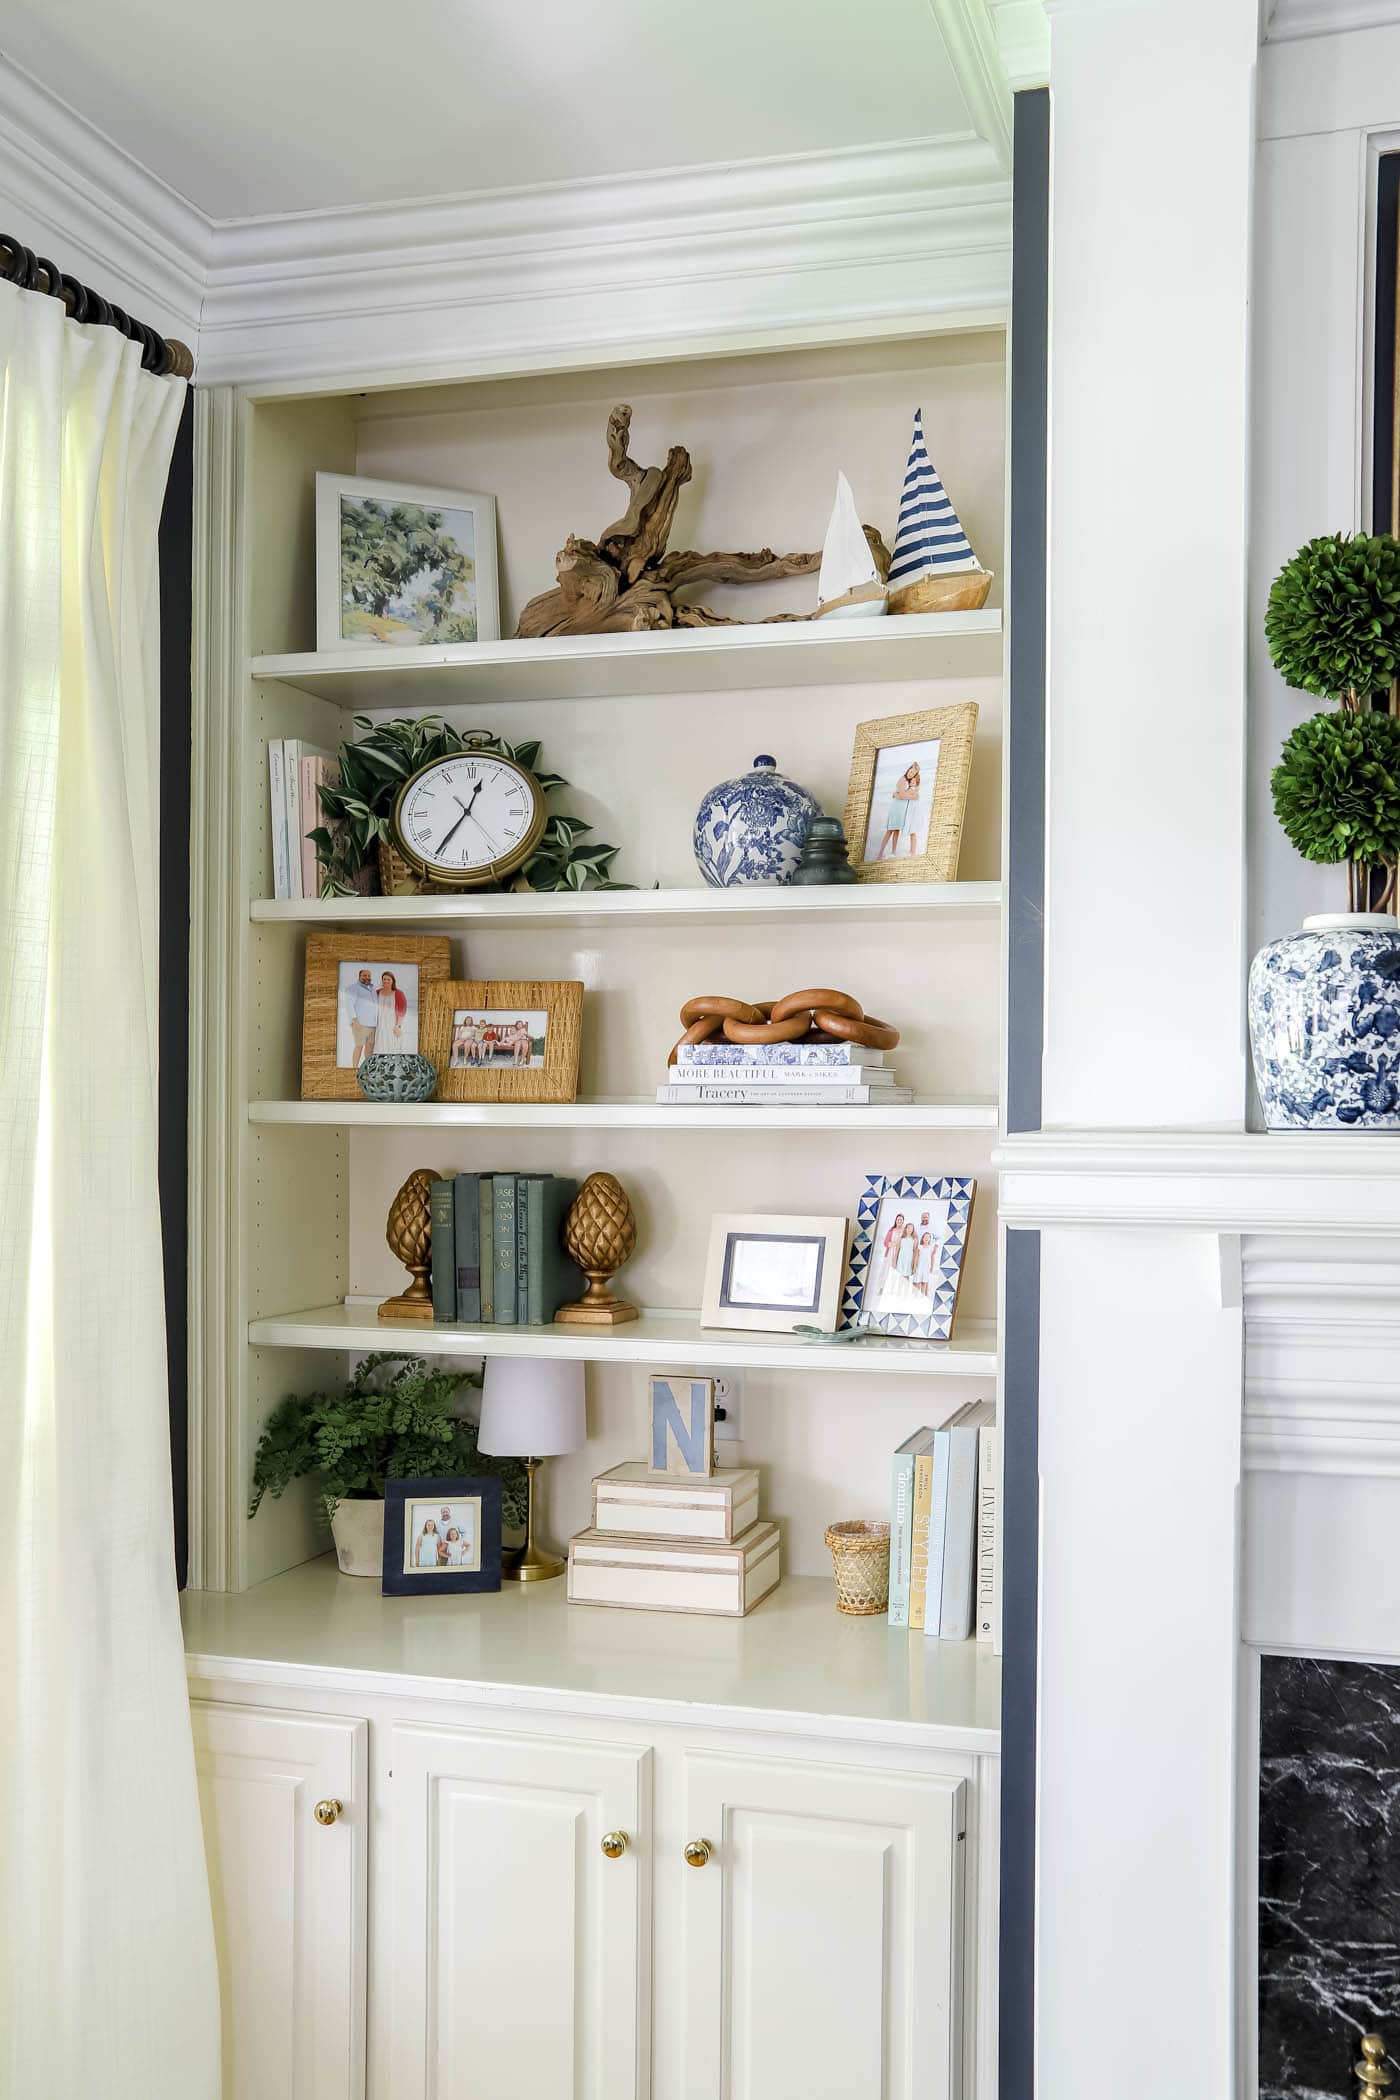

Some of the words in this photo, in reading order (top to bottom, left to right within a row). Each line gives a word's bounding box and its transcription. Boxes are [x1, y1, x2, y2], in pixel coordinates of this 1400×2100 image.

[677, 1069, 710, 1078] MORE
[713, 1069, 778, 1079] BEAUTIFUL
[696, 1085, 748, 1102] Tracery
[652, 1381, 706, 1473] N
[897, 1472, 909, 1524] domino
[981, 1487, 995, 1520] LIVE
[912, 1513, 930, 1593] STYLED
[980, 1524, 995, 1608] BEAUTIFUL
